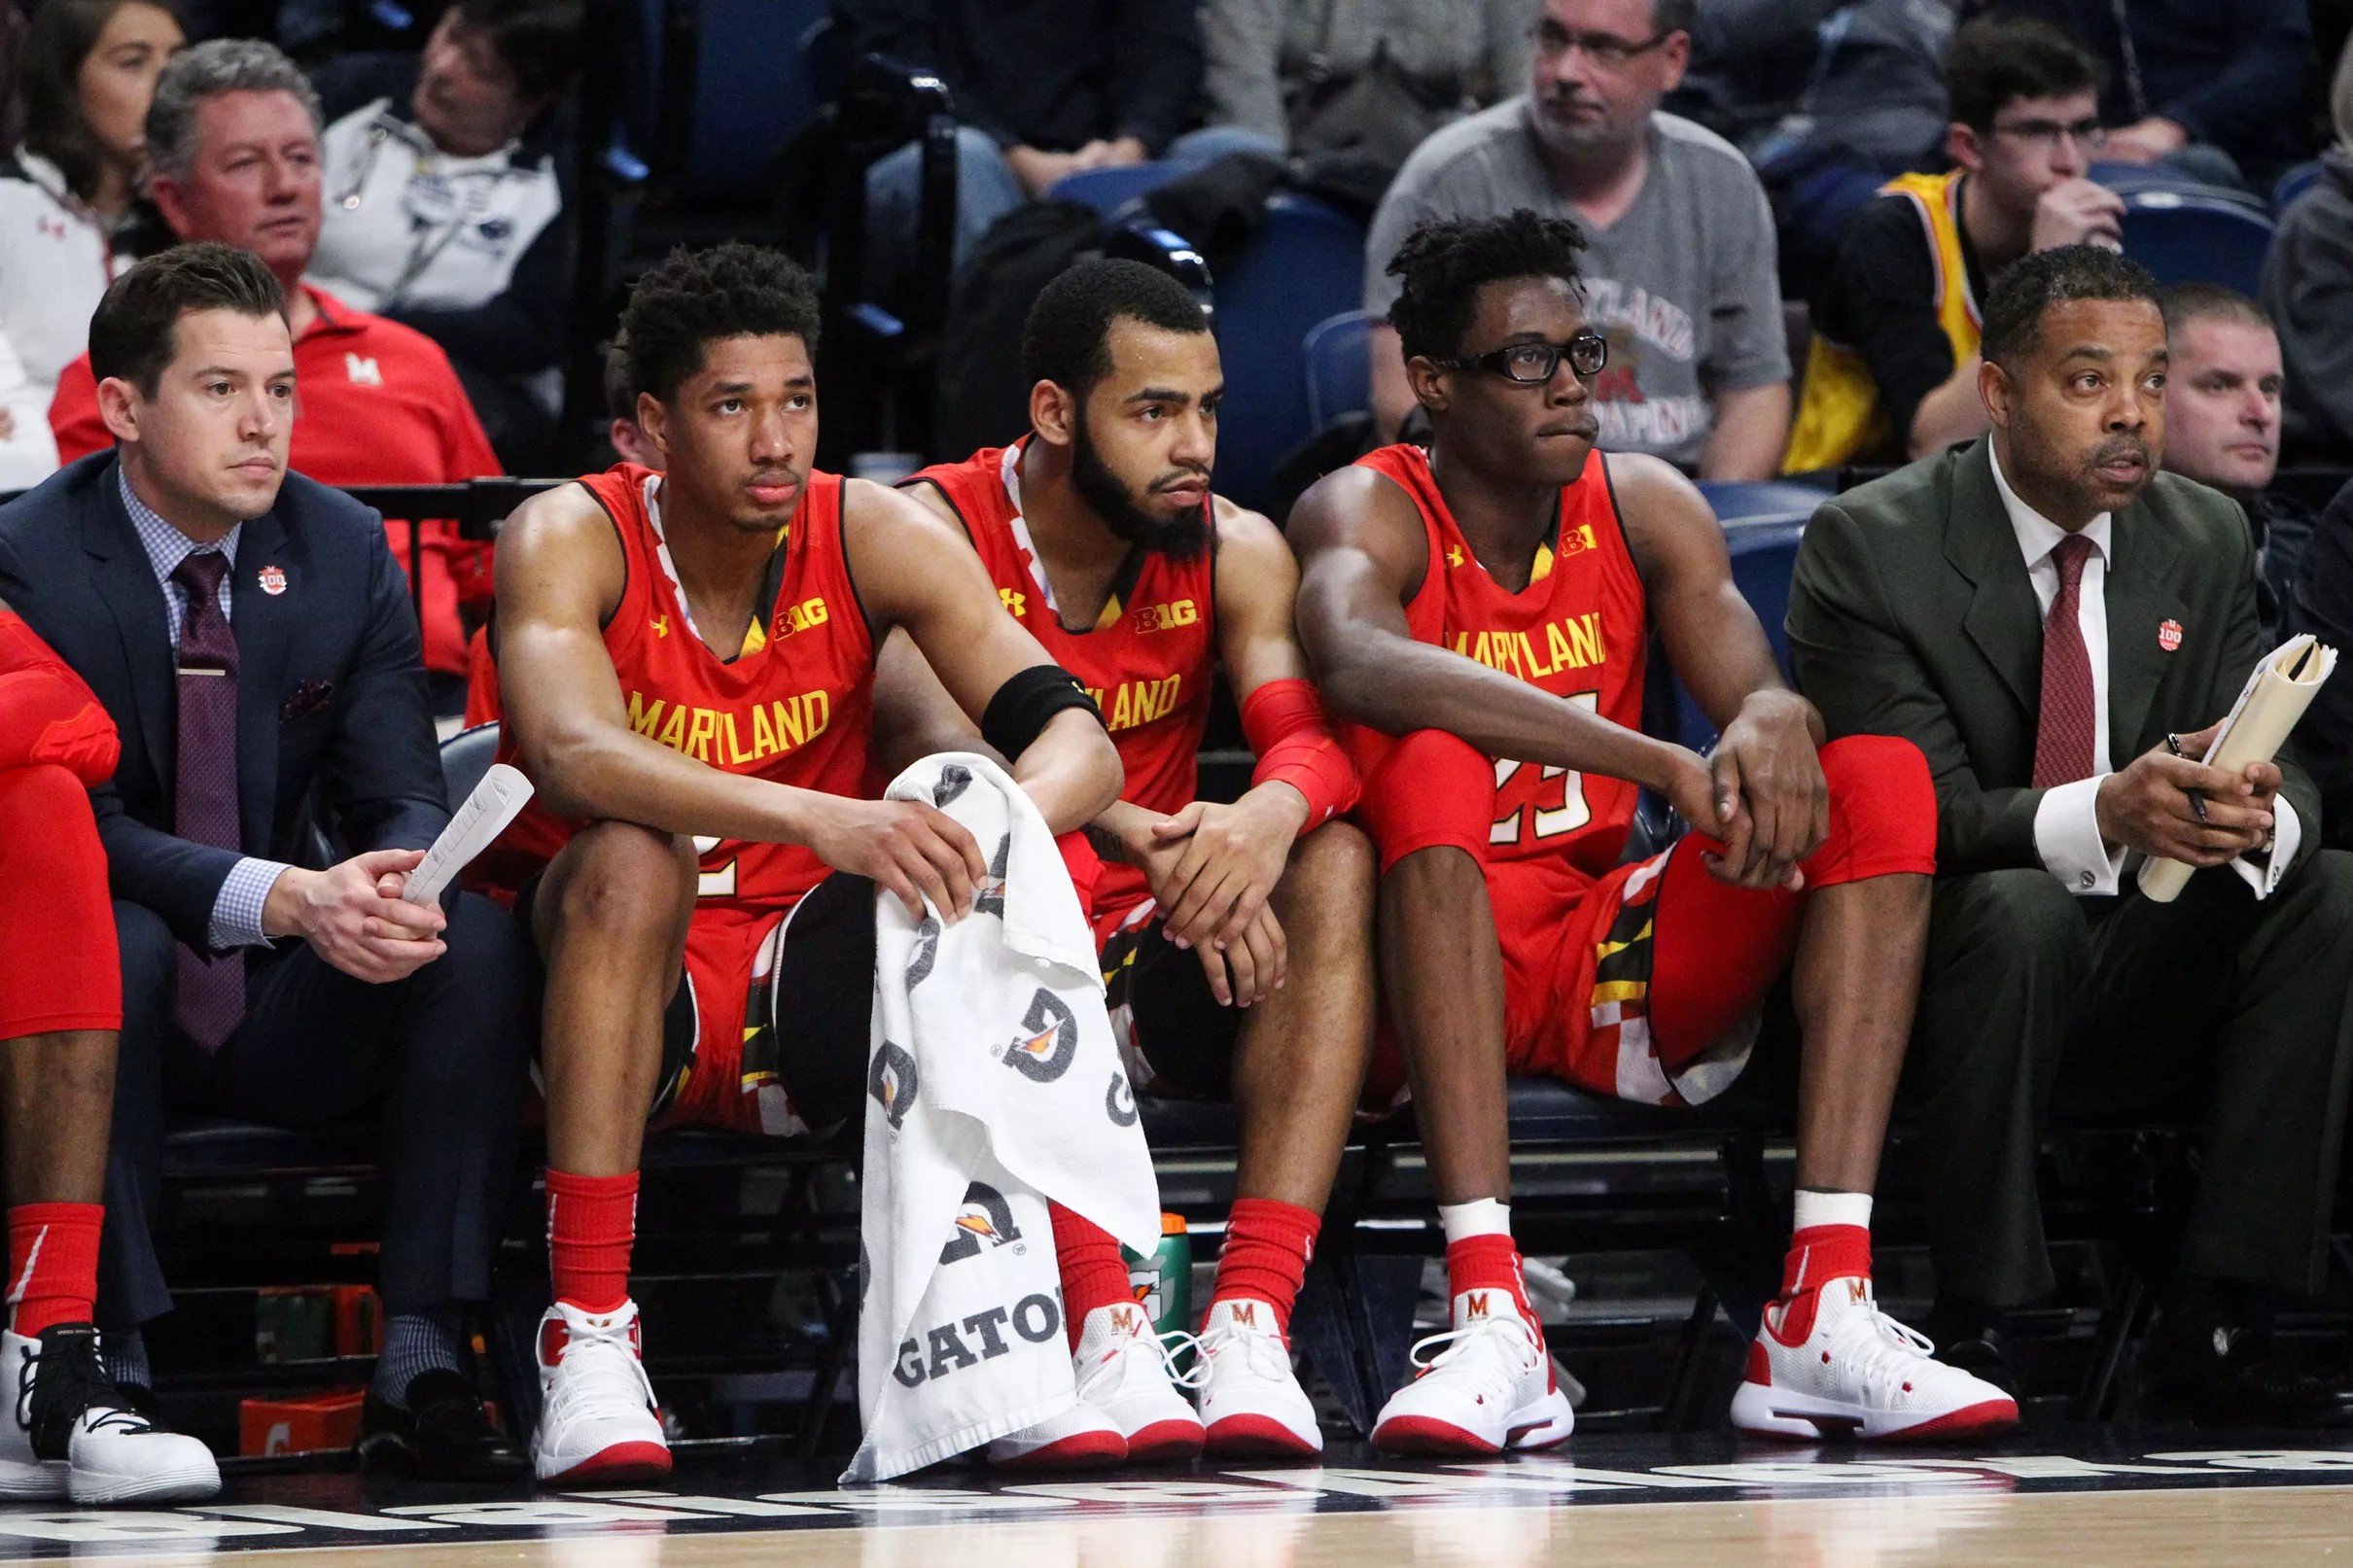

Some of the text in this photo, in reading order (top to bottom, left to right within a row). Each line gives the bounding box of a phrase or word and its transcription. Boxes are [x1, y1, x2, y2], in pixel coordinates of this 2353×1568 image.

[345, 352, 383, 386] M
[1108, 1307, 1136, 1336] M
[1231, 1302, 1257, 1331] M
[1467, 1291, 1490, 1322] M
[892, 1284, 1068, 1389] GATO
